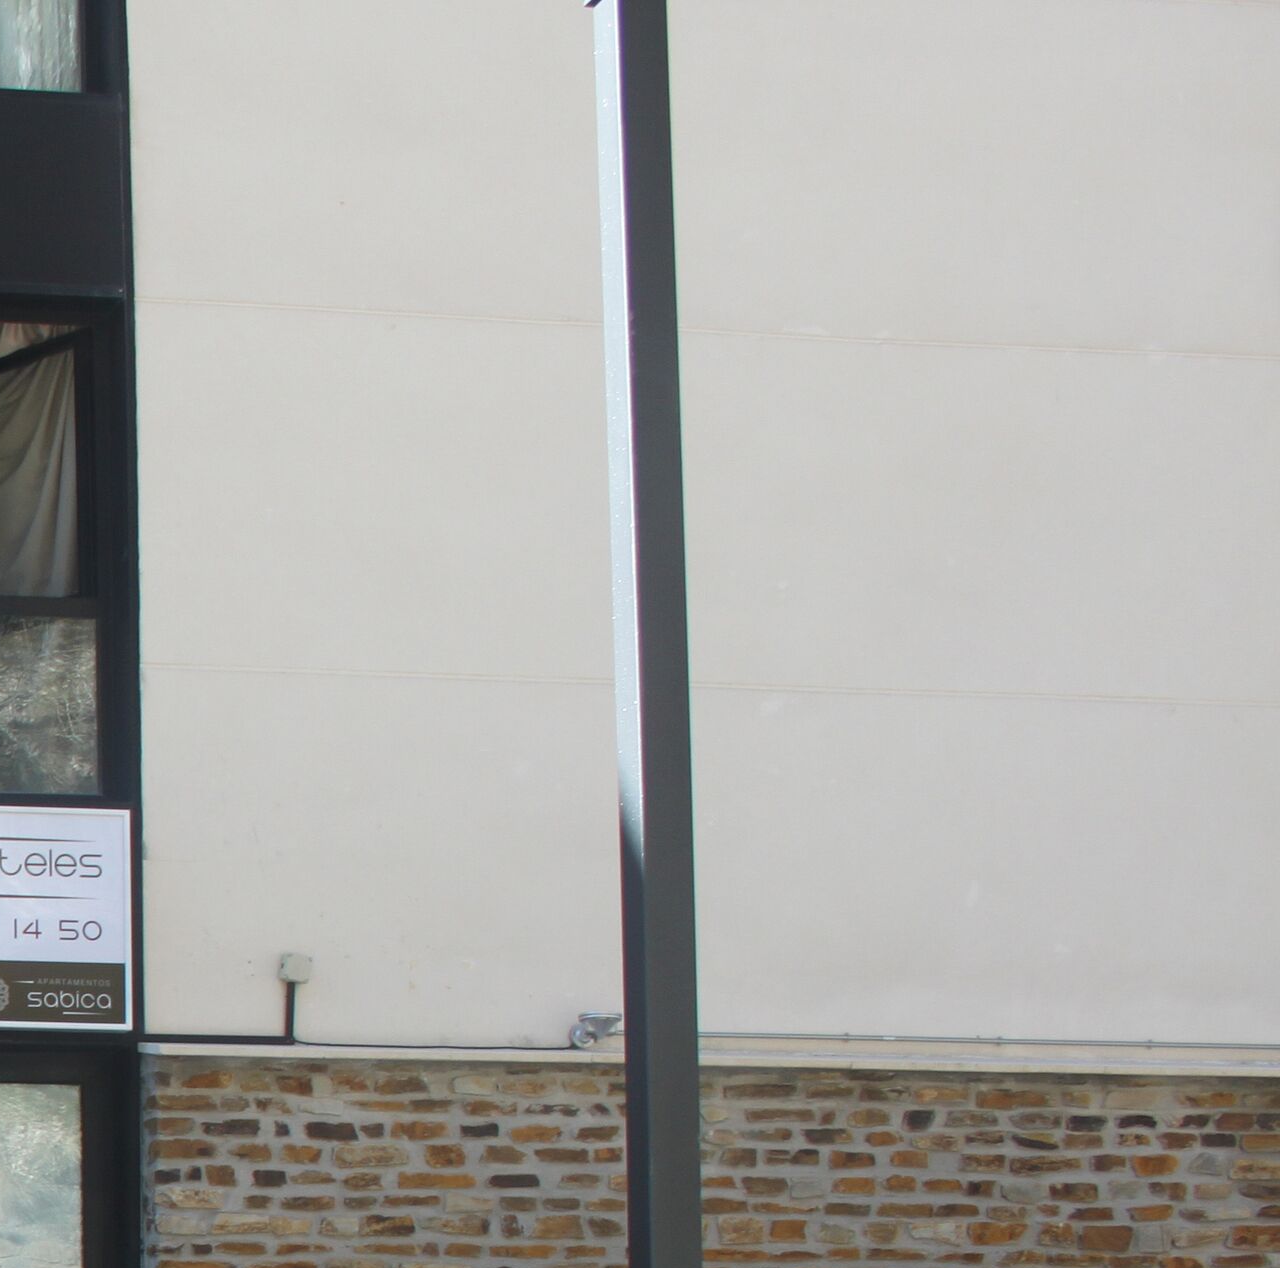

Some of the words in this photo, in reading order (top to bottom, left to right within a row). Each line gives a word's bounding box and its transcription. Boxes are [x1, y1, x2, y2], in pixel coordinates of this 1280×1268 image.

[14, 917, 43, 940] 14
[58, 919, 103, 941] 50
[37, 977, 111, 988] APARTAMENTOS
[27, 989, 112, 1009] sabica
